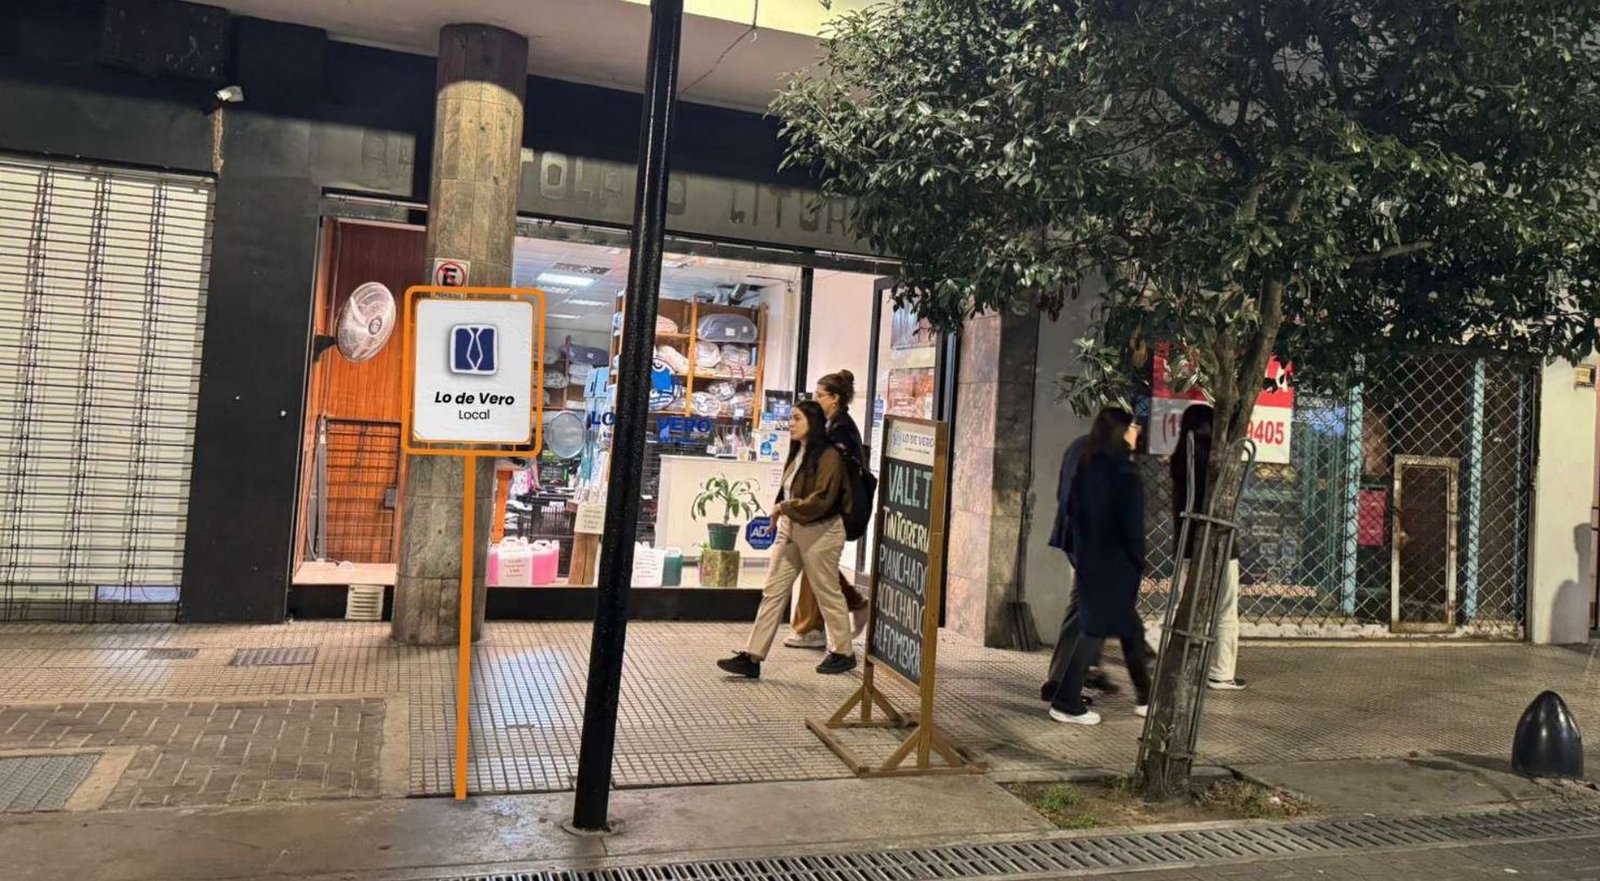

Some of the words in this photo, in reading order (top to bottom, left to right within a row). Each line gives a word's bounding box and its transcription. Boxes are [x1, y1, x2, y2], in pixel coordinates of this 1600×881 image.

[591, 410, 616, 426] LO
[655, 415, 712, 433] VERO
[888, 463, 934, 511] VALET
